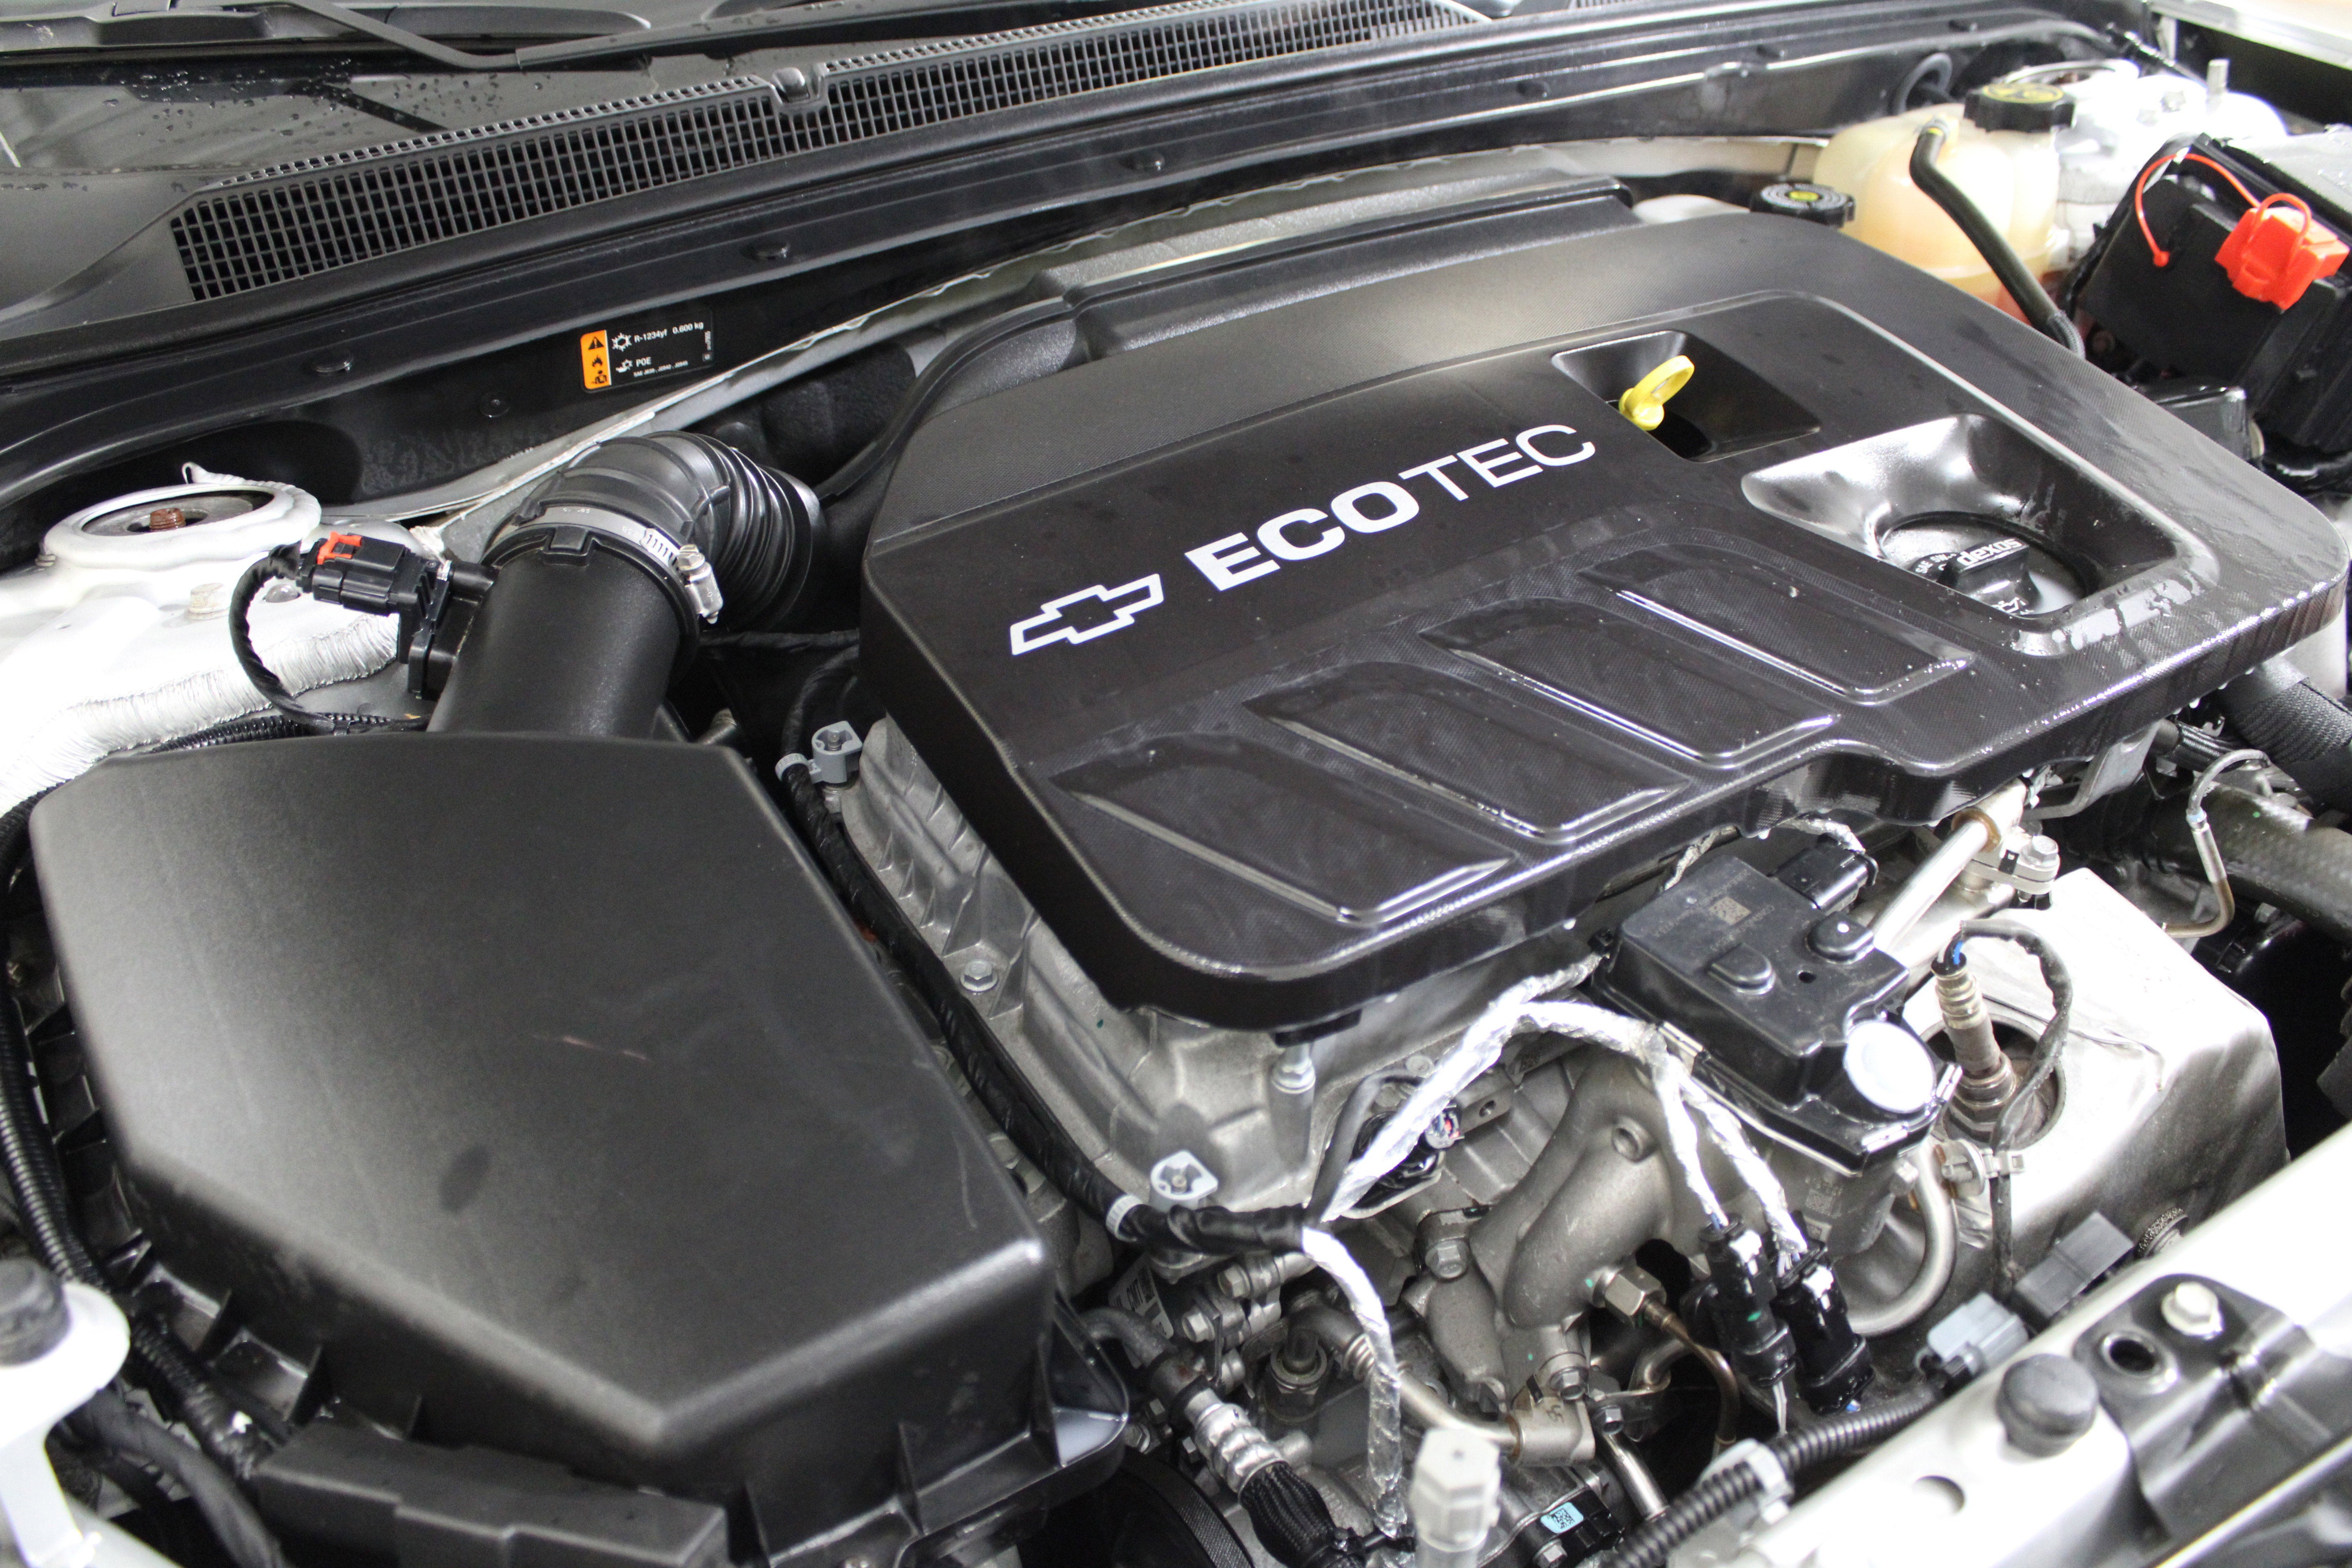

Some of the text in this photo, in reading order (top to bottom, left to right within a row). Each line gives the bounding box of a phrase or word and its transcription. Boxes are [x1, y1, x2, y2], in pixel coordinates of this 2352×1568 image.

[634, 329, 668, 343] R-1234yf
[694, 322, 704, 330] kg
[636, 356, 652, 367] POE
[1184, 424, 1596, 591] ECOTEC
[1956, 538, 2023, 566] dexos
[1915, 560, 1933, 574] SAE
